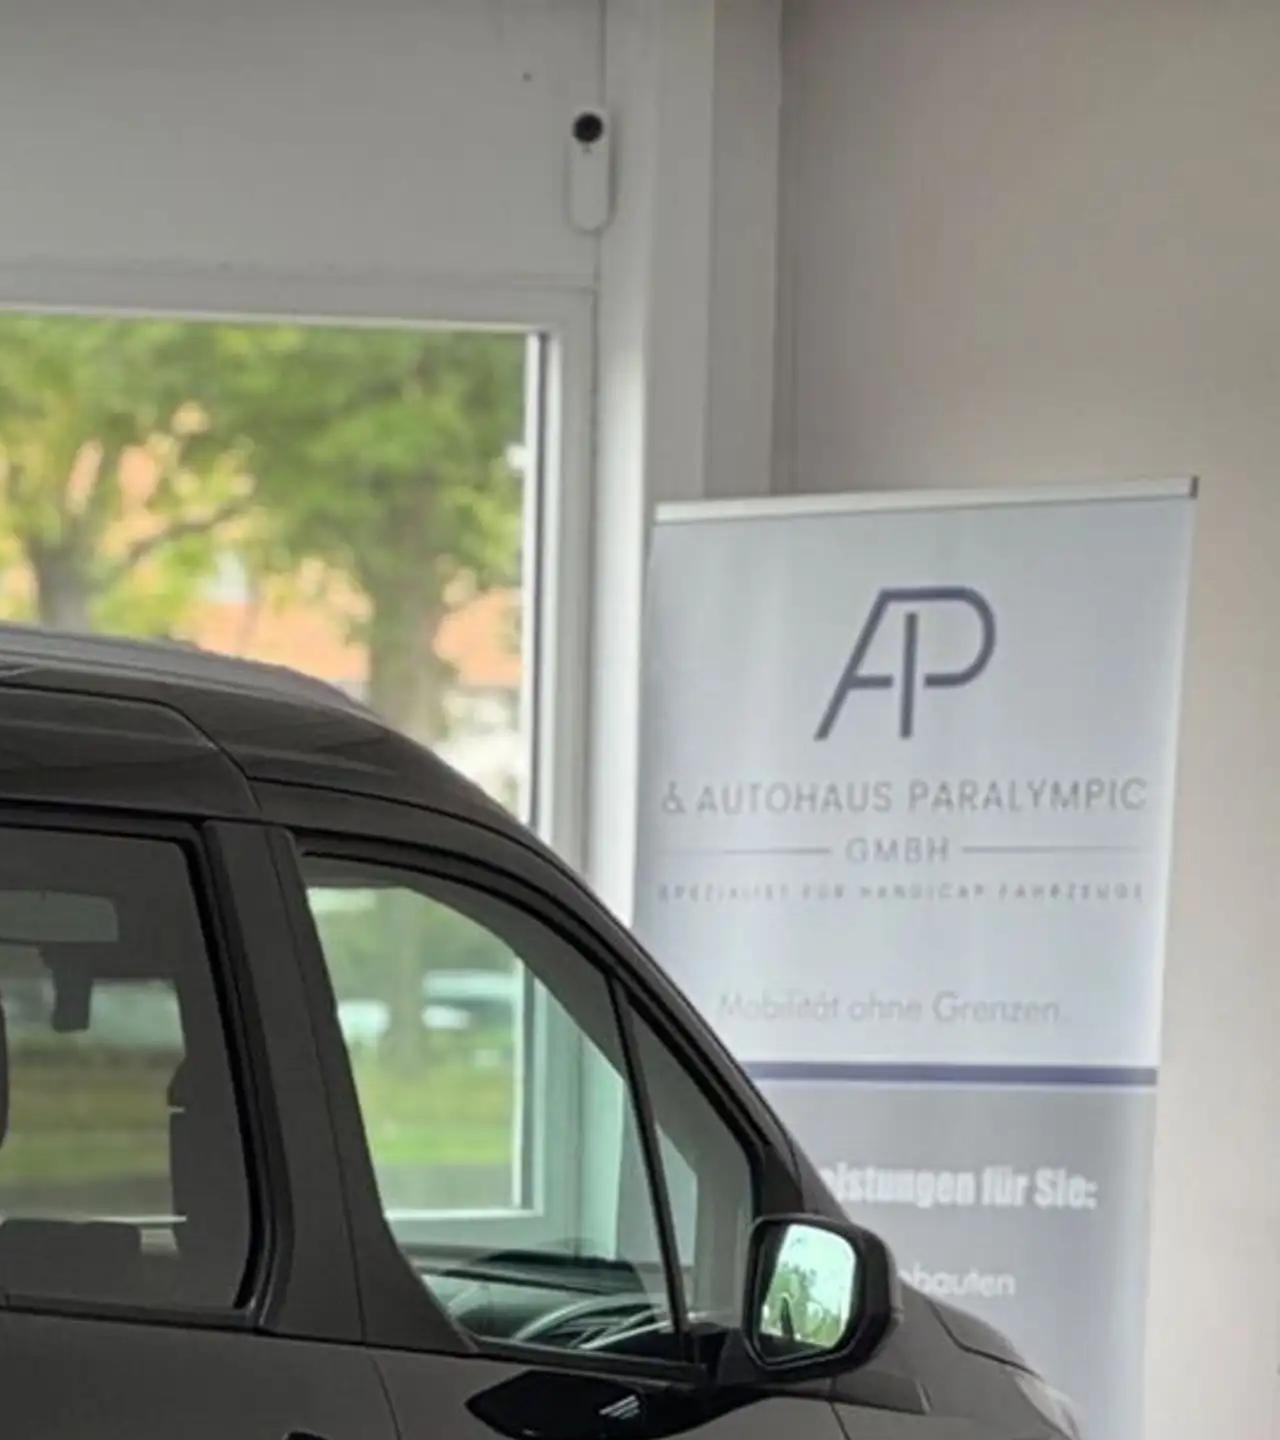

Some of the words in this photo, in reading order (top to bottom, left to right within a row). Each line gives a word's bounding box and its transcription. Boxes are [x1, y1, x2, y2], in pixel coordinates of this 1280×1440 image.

[696, 780, 894, 815] AUTOHAUS
[908, 777, 1149, 812] PARALYMPIC
[844, 837, 951, 865] GMBH
[847, 990, 923, 1021] ohne
[981, 1165, 1030, 1208] für
[1033, 1163, 1099, 1210] Sie:
